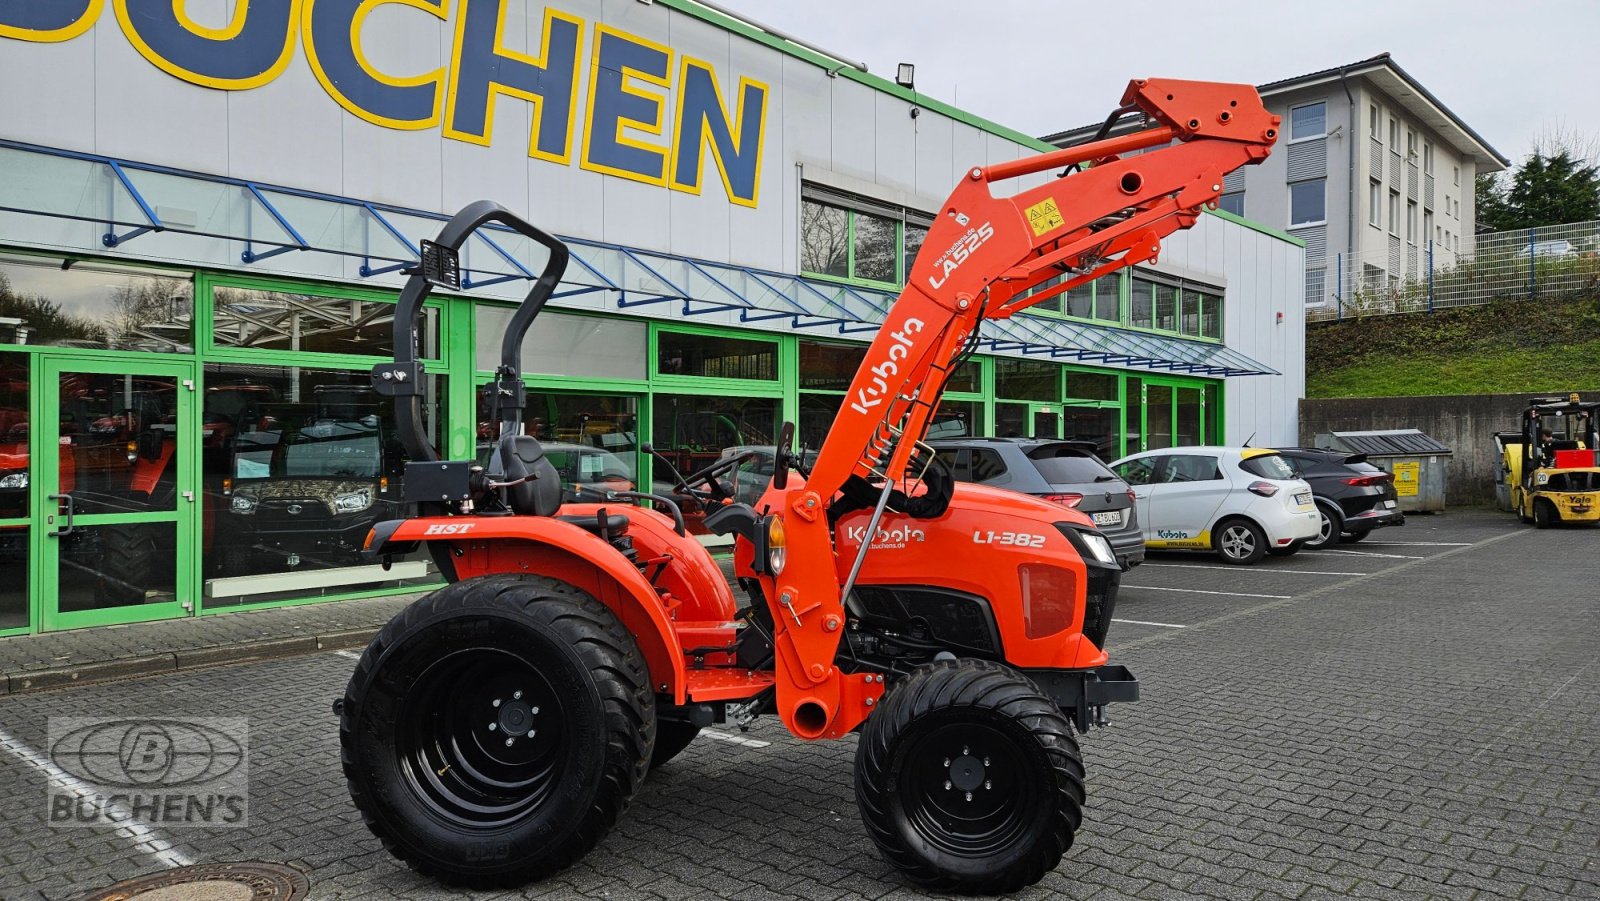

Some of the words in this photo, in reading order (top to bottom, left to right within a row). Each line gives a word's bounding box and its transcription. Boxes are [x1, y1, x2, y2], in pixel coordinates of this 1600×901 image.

[0, 0, 769, 208] UCHEN
[929, 221, 994, 289] LA525
[851, 317, 925, 415] Kubota
[1538, 474, 1547, 482] 20
[424, 523, 475, 535] HST
[1157, 530, 1188, 539] Kubota
[973, 531, 1046, 548] L1-382
